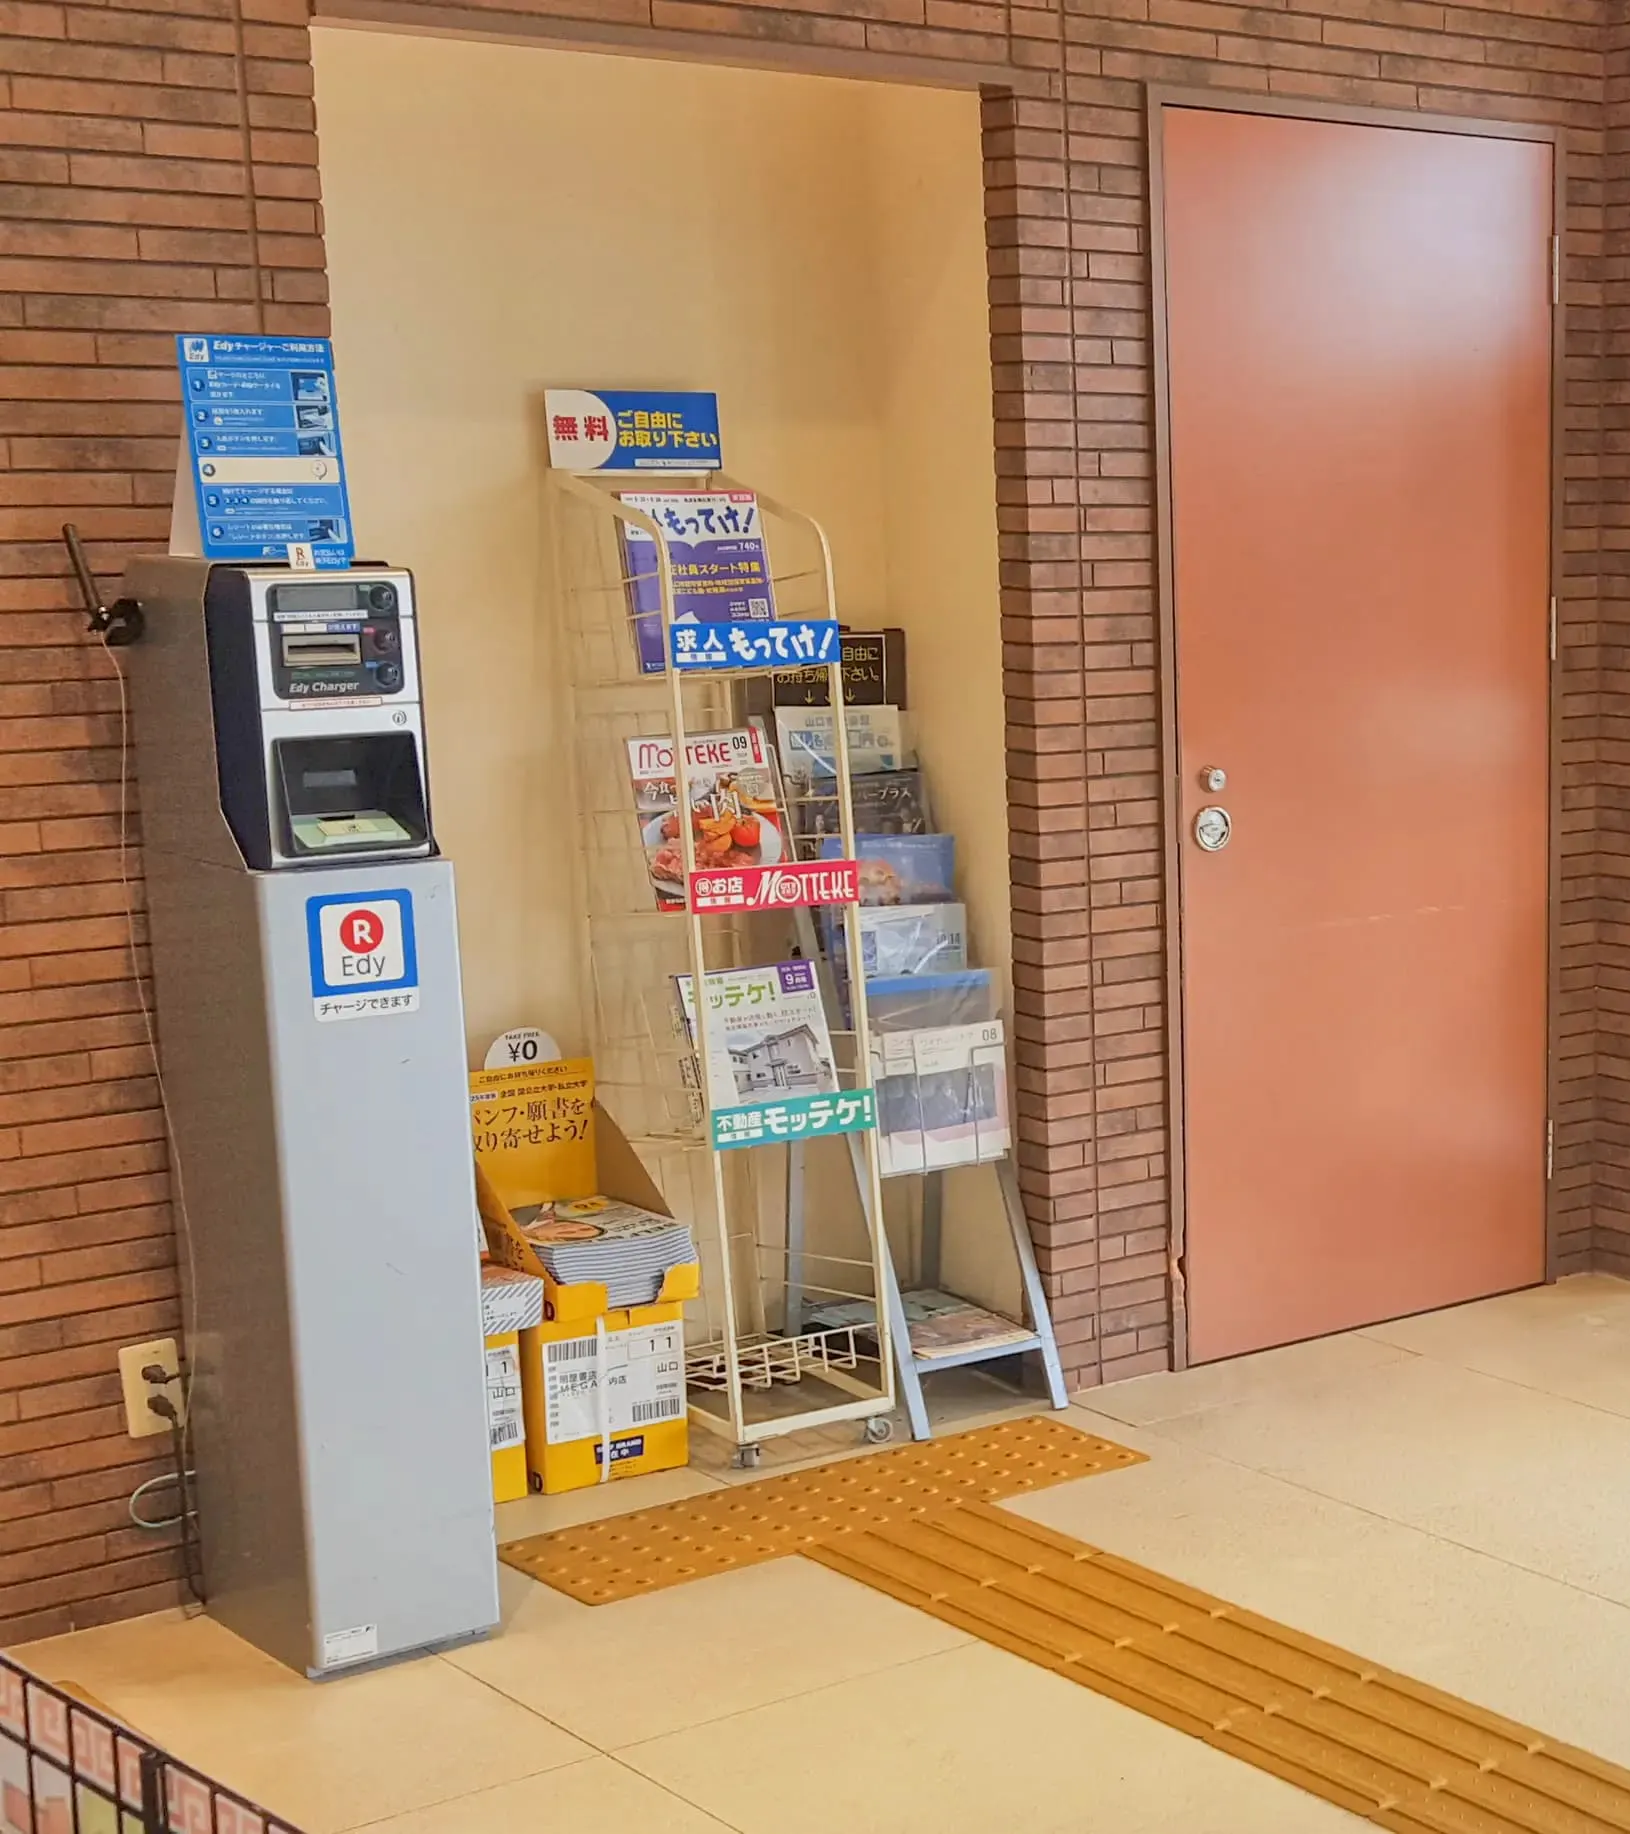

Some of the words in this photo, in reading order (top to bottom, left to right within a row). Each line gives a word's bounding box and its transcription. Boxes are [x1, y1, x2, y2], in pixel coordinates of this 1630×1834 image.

[553, 415, 609, 442] 無料
[617, 410, 683, 429] ご自由に
[618, 430, 718, 448] お取り下さい
[675, 630, 723, 650] 求人
[729, 624, 834, 661] もってけ!
[842, 646, 880, 661] 自由に
[289, 683, 310, 694] Edy
[312, 681, 360, 693] Charger
[732, 736, 748, 750] 09
[639, 742, 731, 769] MOTEKE
[746, 870, 854, 905] MOTTEKE
[341, 954, 386, 977] Edy
[320, 994, 413, 1015] チャージできます
[982, 1028, 997, 1041] 08
[508, 1040, 538, 1062] ¥0
[717, 1111, 762, 1132] 不動産
[764, 1095, 872, 1134] モッテケ!
[657, 1360, 679, 1373] 山口
[492, 1386, 516, 1399] 山口
